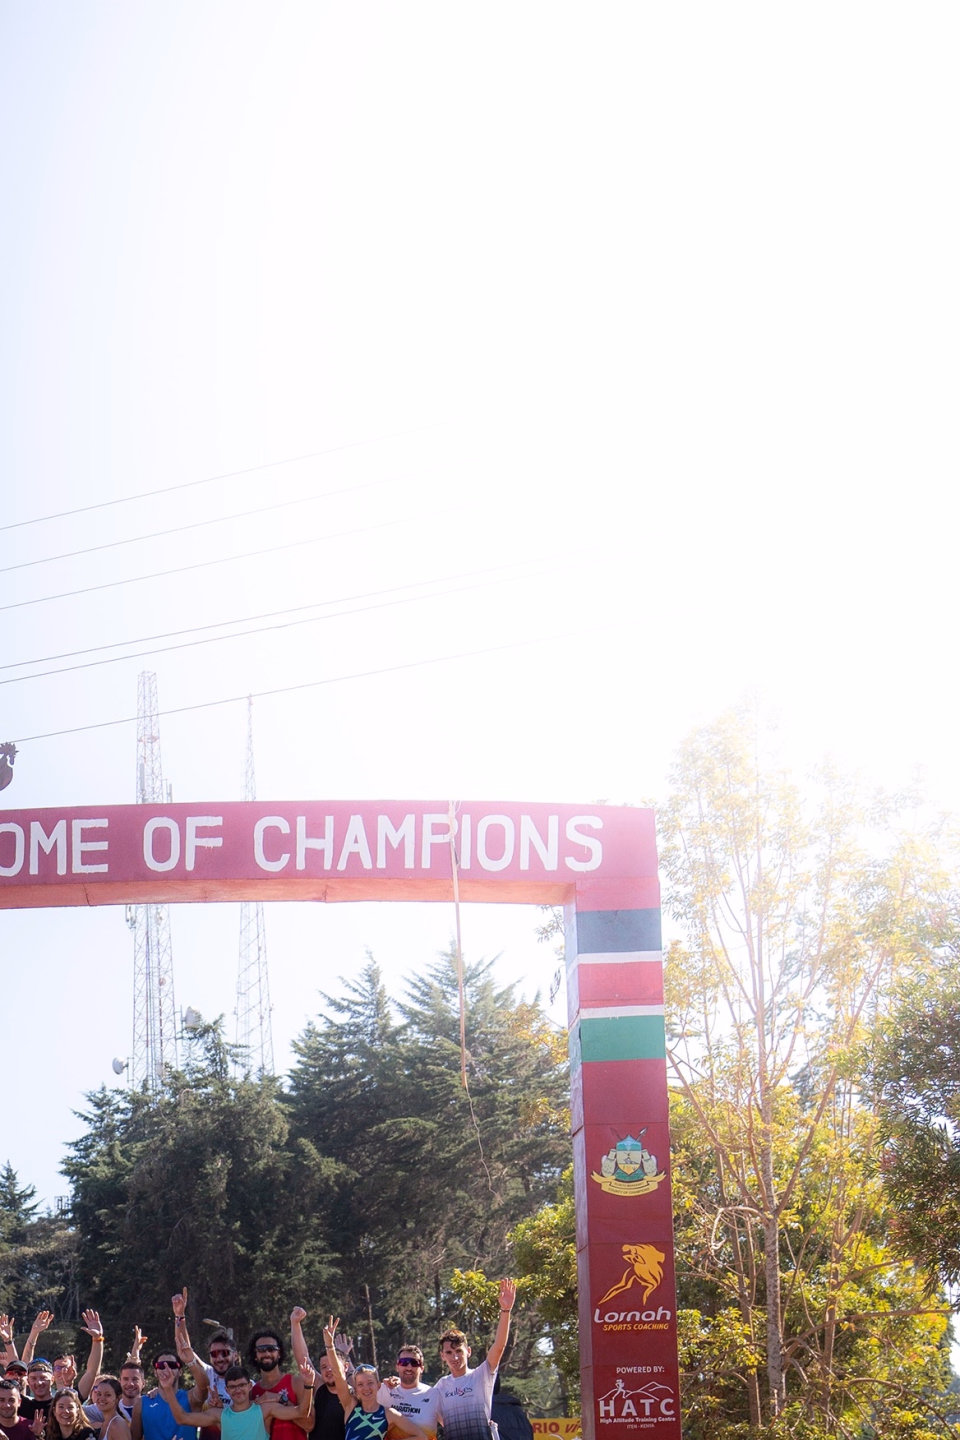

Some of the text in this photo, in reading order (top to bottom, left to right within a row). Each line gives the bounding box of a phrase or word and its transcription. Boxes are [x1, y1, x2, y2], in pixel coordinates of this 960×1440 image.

[143, 815, 224, 872] OF
[253, 812, 605, 873] CHAMPIONS
[594, 1306, 671, 1323] Lornah
[653, 1365, 665, 1373] BY:
[600, 1398, 675, 1417] HATC
